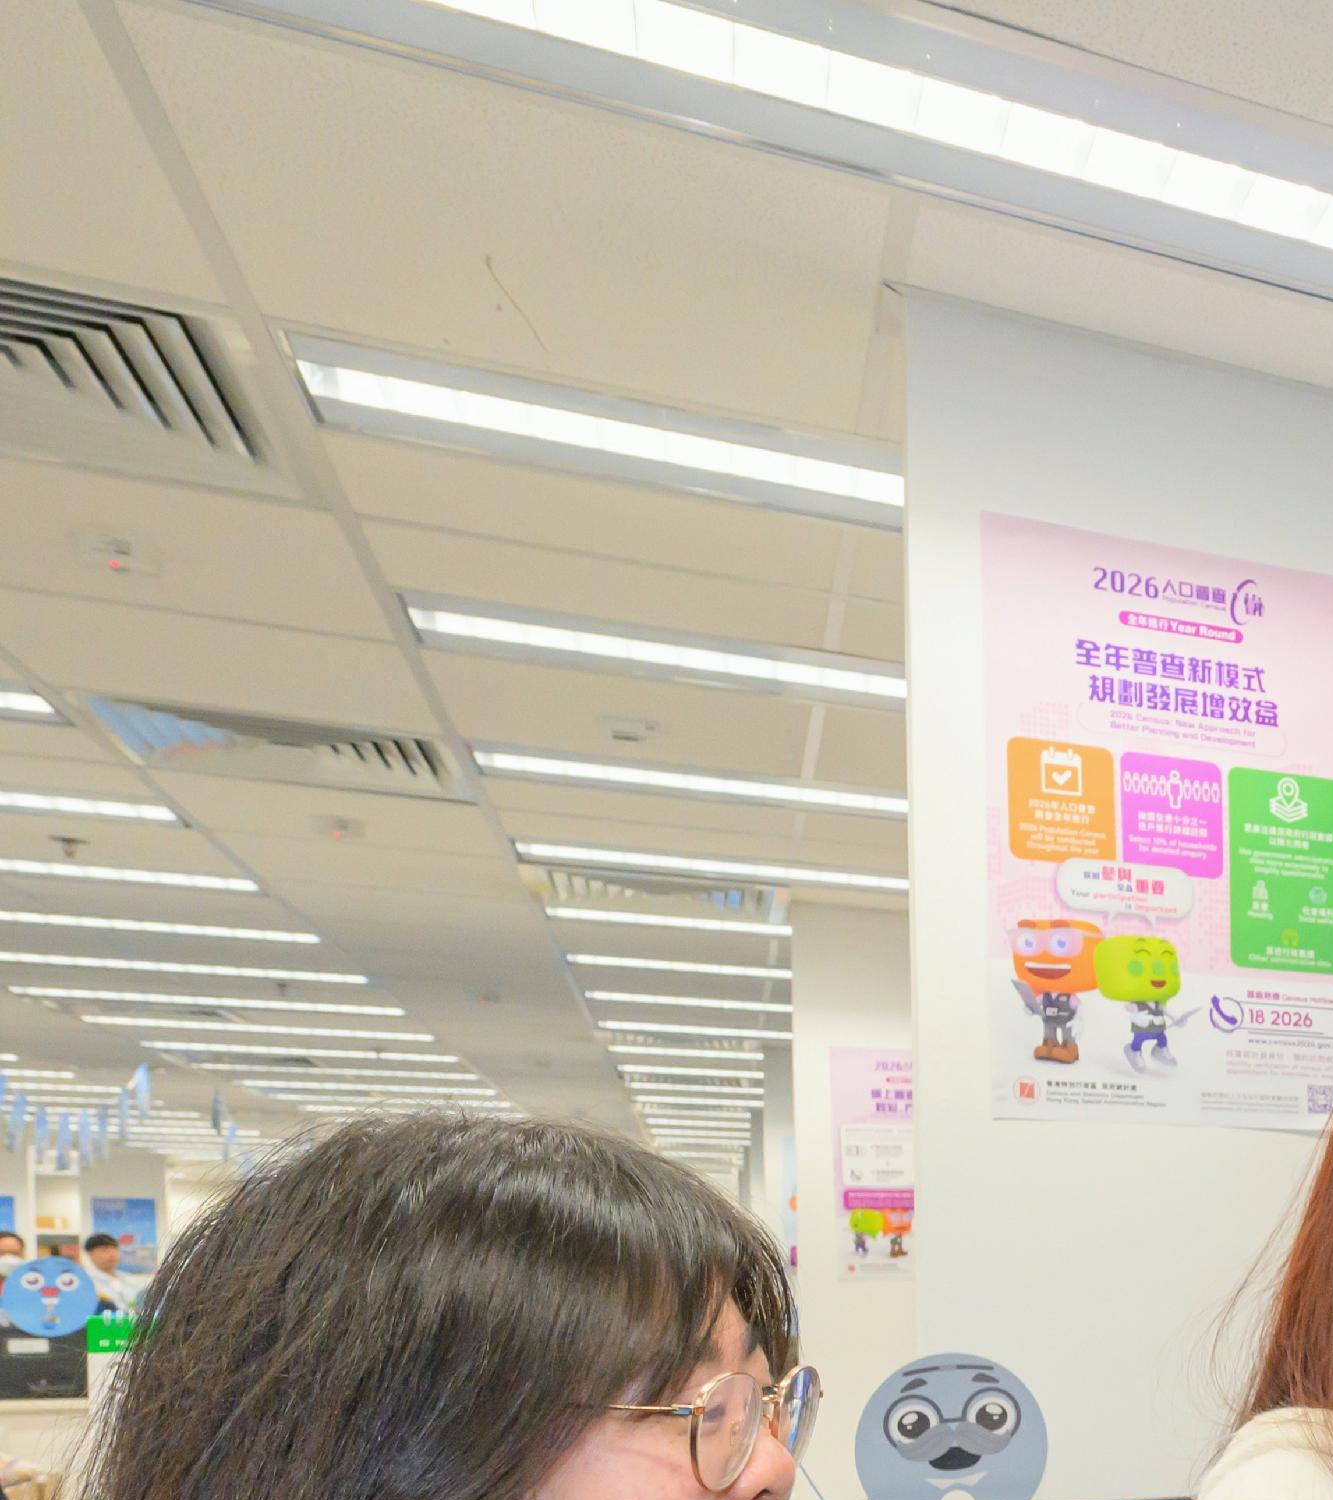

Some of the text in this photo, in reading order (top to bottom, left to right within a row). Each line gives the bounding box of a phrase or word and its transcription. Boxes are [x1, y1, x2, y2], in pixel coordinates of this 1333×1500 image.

[1169, 620, 1198, 637] Year
[1198, 626, 1236, 641] Round
[1075, 638, 1267, 693] 全年普查新模式
[1088, 674, 1280, 727] 規劃發展增效益
[1249, 1008, 1313, 1029] 18 2026
